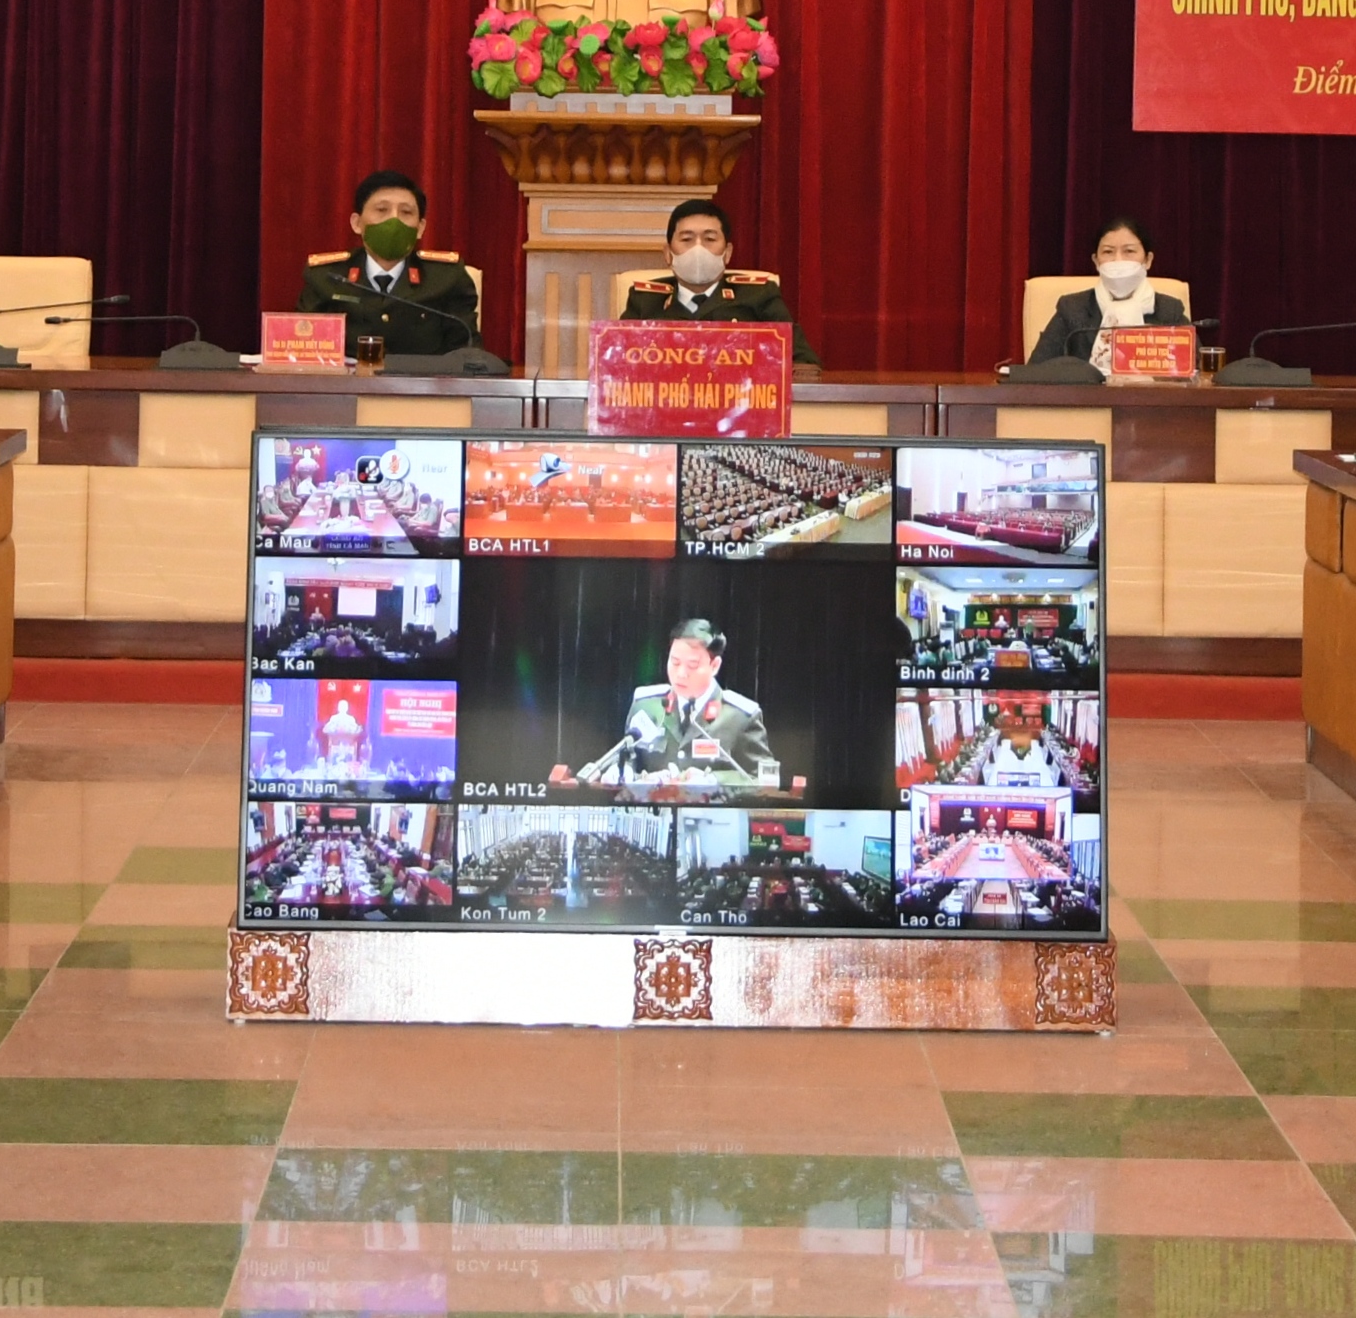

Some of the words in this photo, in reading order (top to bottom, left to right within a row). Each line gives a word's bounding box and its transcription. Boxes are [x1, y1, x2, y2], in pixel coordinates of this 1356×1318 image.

[625, 340, 705, 365] CÔNG
[714, 349, 755, 365] AN
[603, 377, 654, 407] THÀNH
[658, 373, 689, 408] PHỐ
[694, 372, 720, 408] HẢI
[280, 535, 312, 548] Mau
[468, 539, 503, 553] BCA
[509, 539, 550, 553] HTL1
[685, 541, 751, 556] TP.HCM
[756, 543, 765, 556] 2
[901, 545, 922, 558] Ha
[928, 545, 954, 558] Noi
[284, 657, 315, 670] Kan
[900, 666, 936, 680] Binh
[941, 666, 975, 681] dinh
[980, 667, 990, 681] 2
[302, 779, 338, 794] Nam
[463, 782, 499, 797] BCA
[505, 783, 546, 797] HTL2
[279, 904, 319, 920] Bang
[461, 907, 493, 921] Kon
[497, 907, 533, 921] Tum
[537, 908, 547, 922] 2
[681, 909, 710, 924] Can
[717, 909, 747, 924] Tho
[900, 914, 928, 927] Lao
[935, 913, 961, 927] Cai
